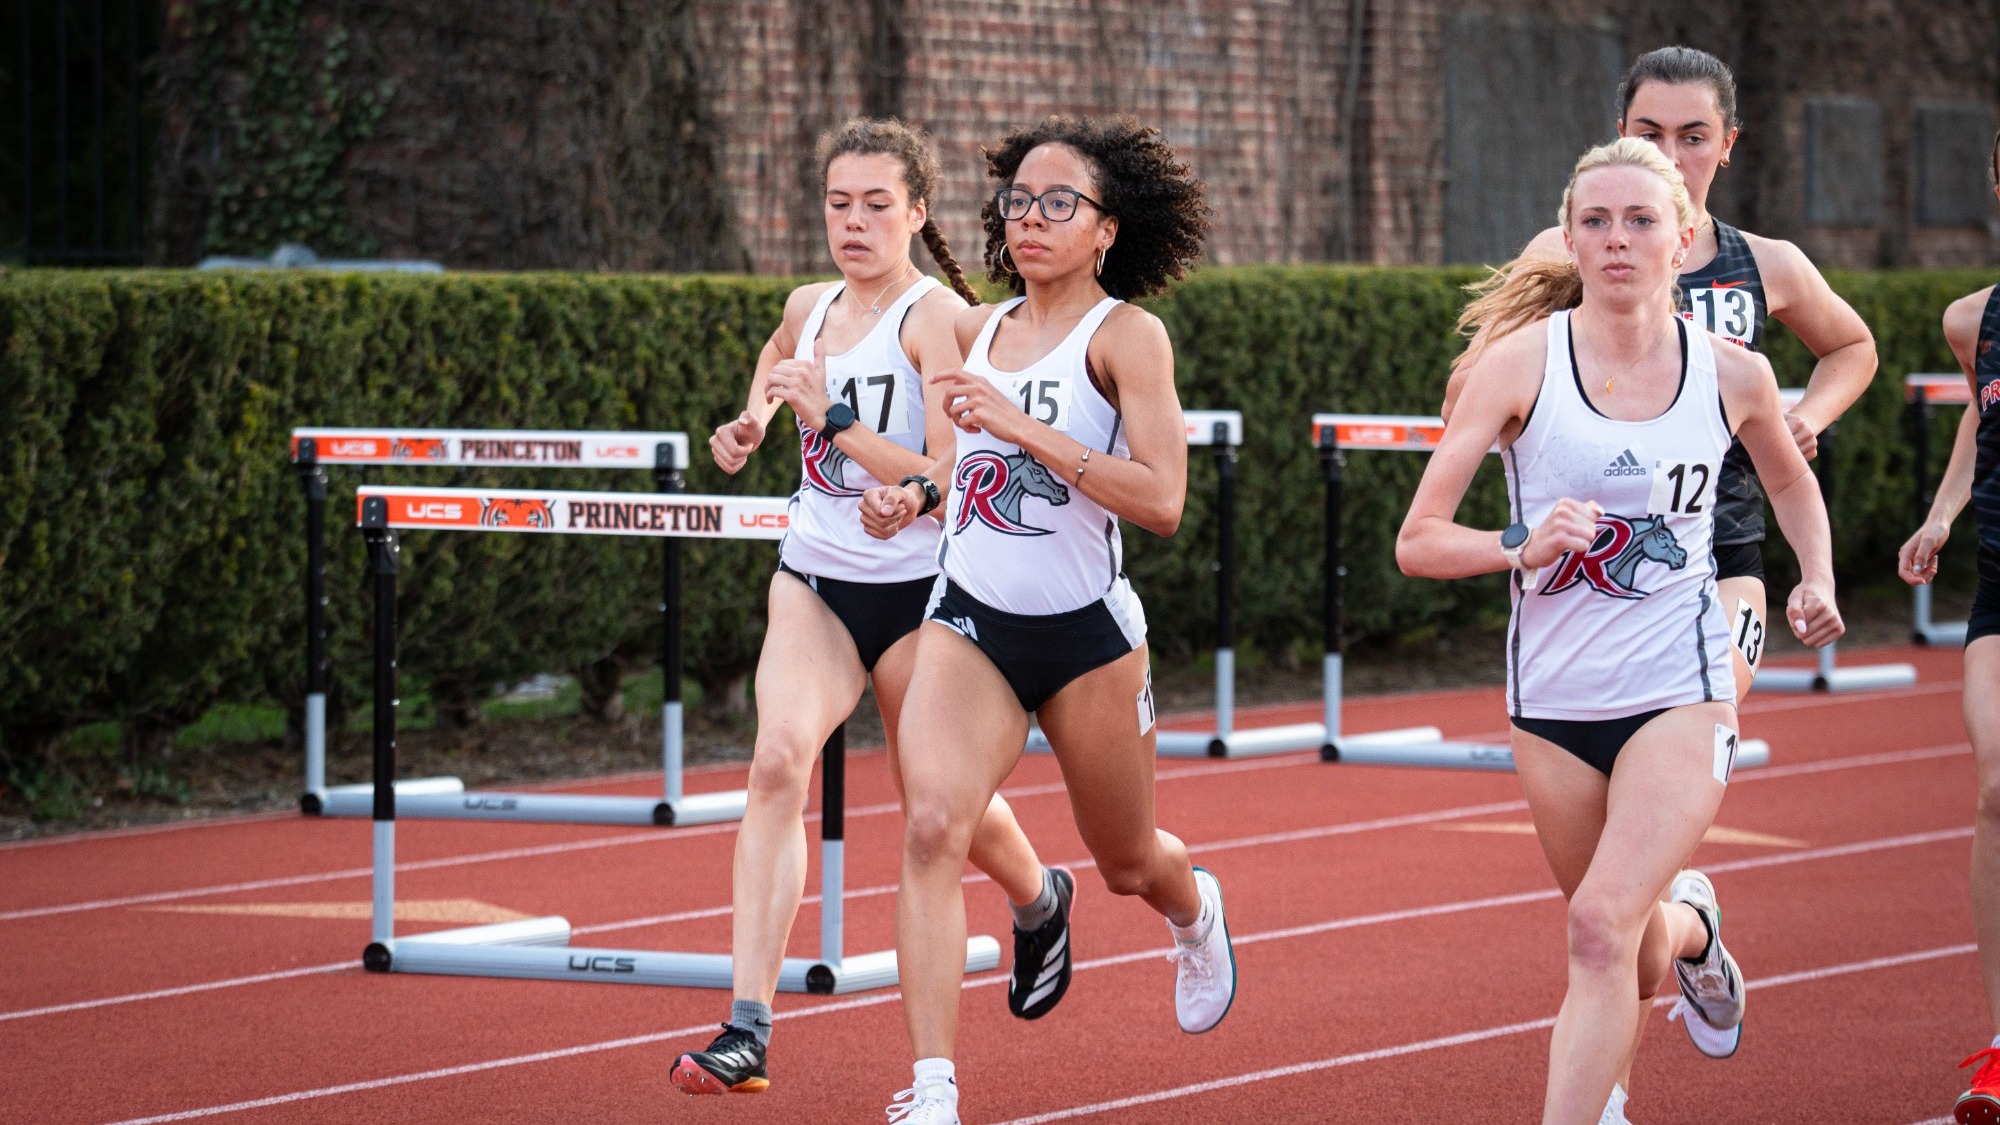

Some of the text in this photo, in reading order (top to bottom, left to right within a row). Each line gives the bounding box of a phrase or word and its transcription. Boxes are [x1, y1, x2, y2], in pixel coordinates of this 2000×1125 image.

[1696, 289, 1748, 337] 13
[840, 373, 895, 434] 17
[1019, 380, 1060, 426] 15
[330, 438, 639, 461] UCS PRINCETON UCS
[1603, 465, 1647, 478] adidas
[1667, 463, 1709, 514] 12
[406, 501, 789, 533] UCS PRINCETON UCS
[1738, 606, 1763, 666] 13
[1726, 733, 1738, 782] 1
[464, 798, 517, 811] UCS
[569, 956, 636, 973] UCS
